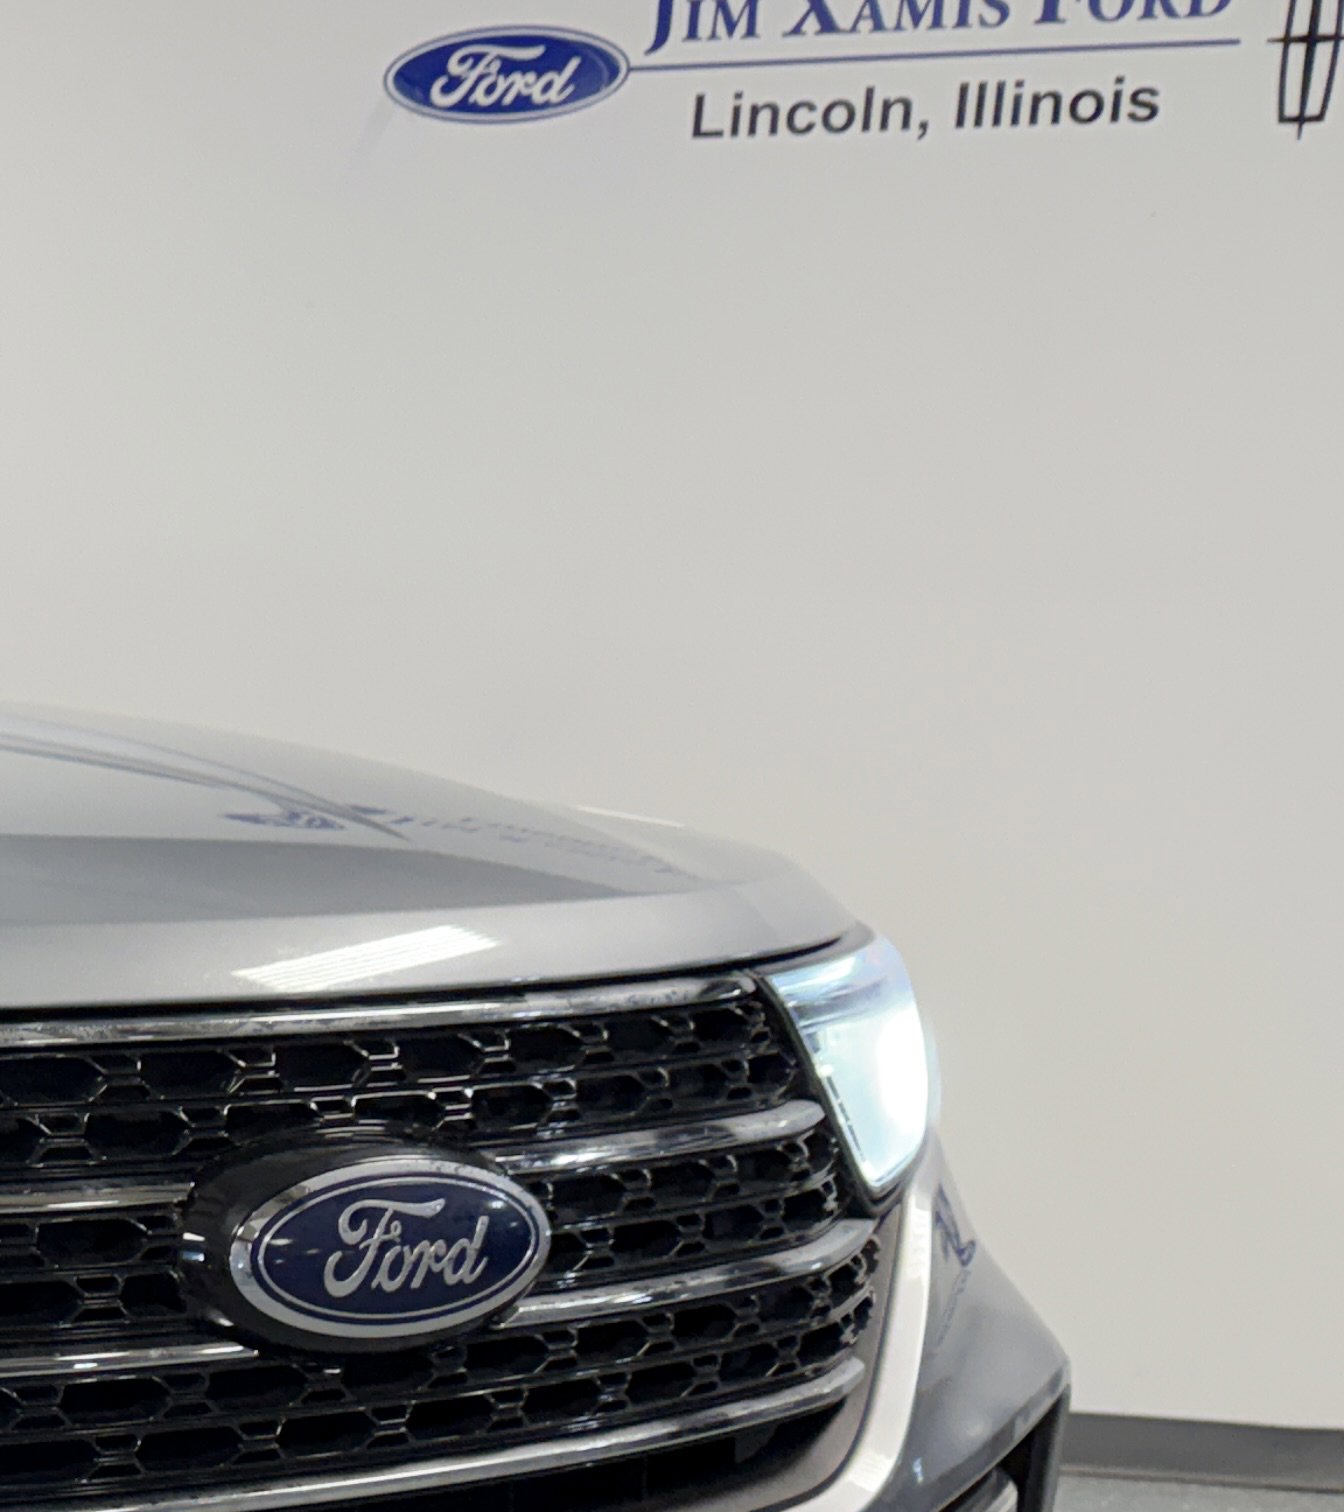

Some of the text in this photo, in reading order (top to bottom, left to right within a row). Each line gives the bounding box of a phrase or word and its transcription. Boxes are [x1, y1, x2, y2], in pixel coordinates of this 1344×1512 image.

[430, 44, 581, 108] Ford
[692, 76, 1160, 140] Lincoln, Illinois
[324, 1198, 489, 1298] Ford
